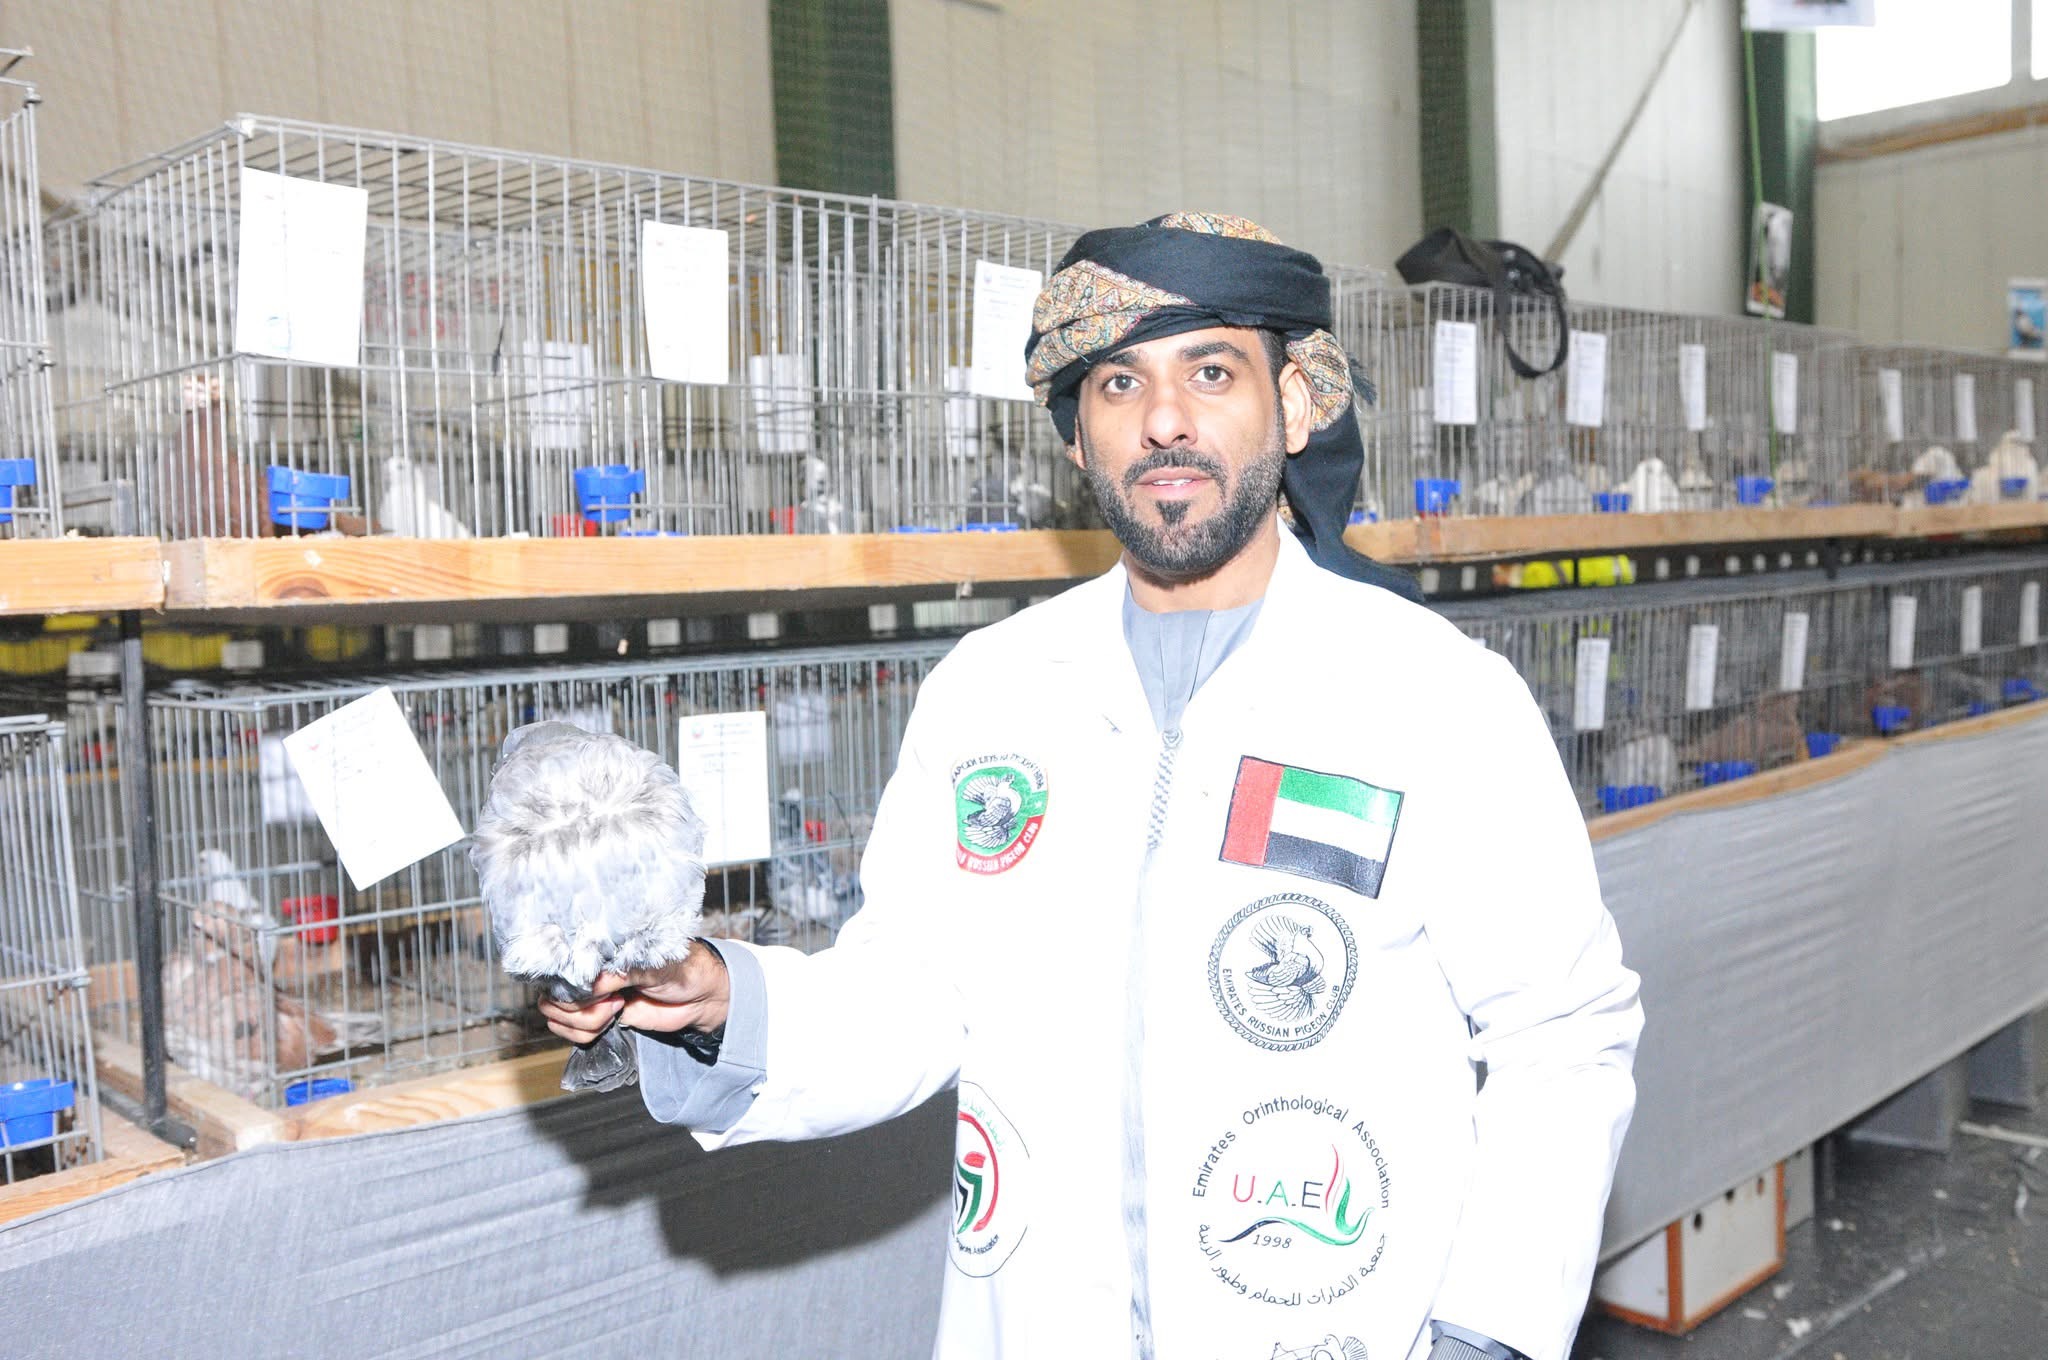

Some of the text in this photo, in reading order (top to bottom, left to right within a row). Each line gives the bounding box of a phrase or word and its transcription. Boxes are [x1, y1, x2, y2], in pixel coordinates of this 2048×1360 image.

[1222, 968, 1341, 1038] EMIRATES RUSSIAN PIGEON CLUB
[1192, 1095, 1390, 1209] Emirates Orinthological Association
[1252, 1234, 1292, 1249] 1998
[1211, 1266, 1247, 1295] وطيور
[1248, 1287, 1301, 1307] للحمام
